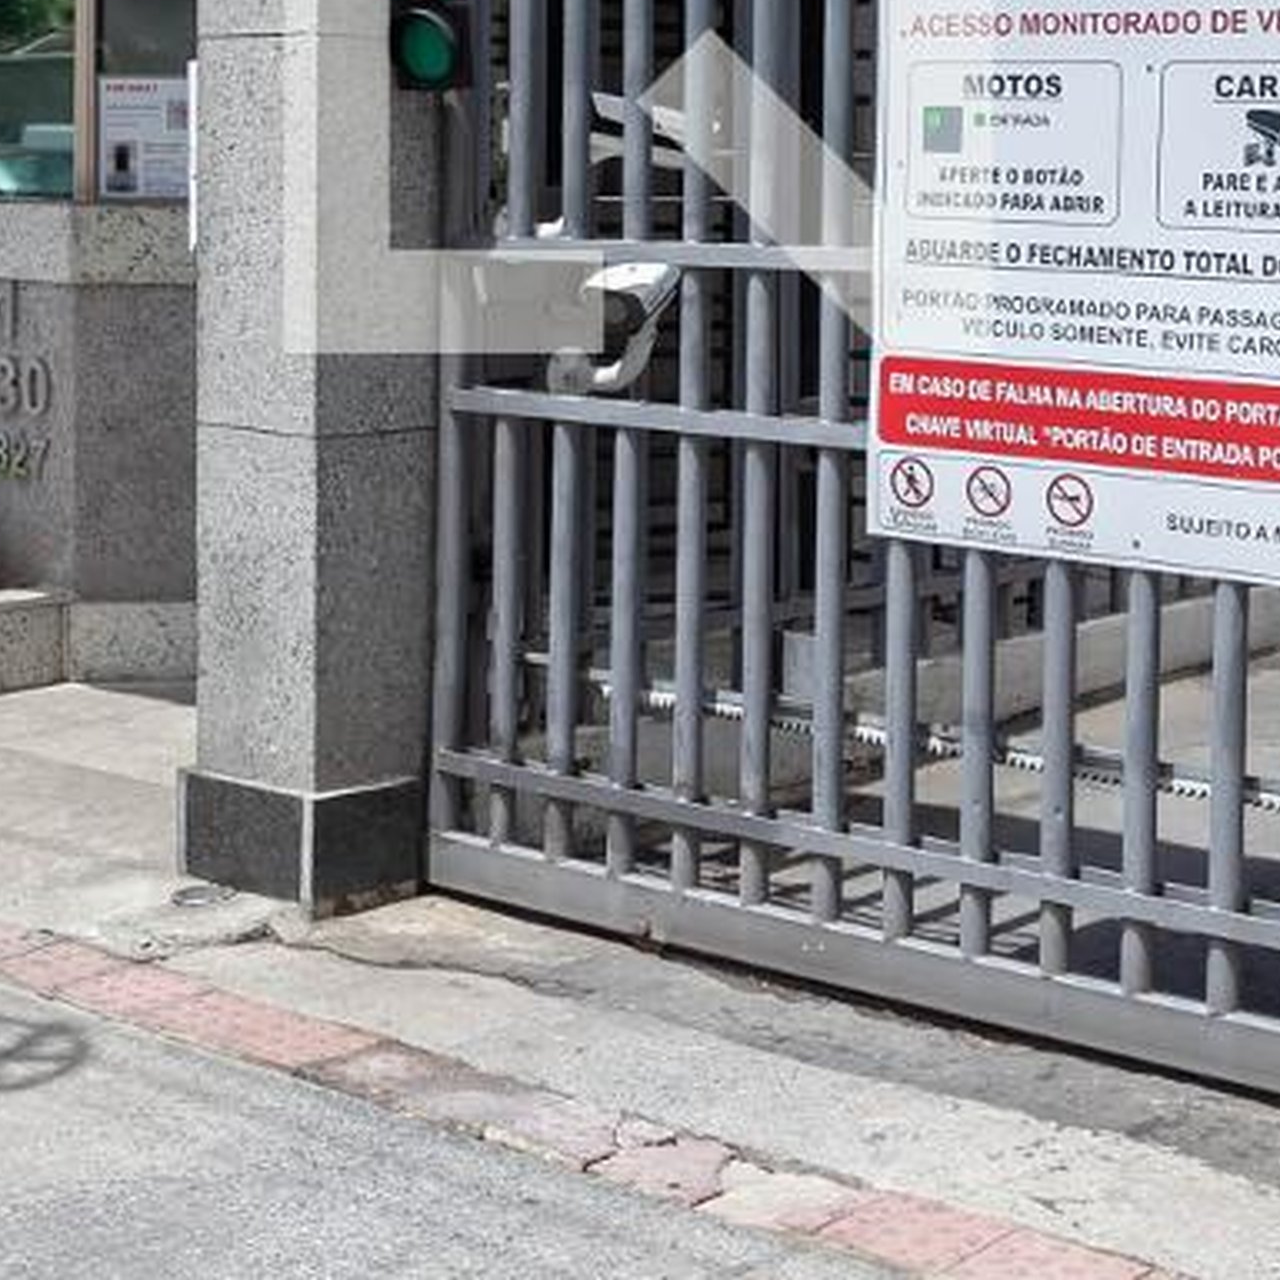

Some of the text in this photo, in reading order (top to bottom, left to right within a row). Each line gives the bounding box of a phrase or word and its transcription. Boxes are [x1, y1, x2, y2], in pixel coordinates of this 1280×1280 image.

[909, 12, 1013, 38] ACESSO
[1021, 10, 1201, 36] MONITORADO
[1211, 9, 1248, 34] DE
[963, 74, 1063, 98] MOTOS
[1006, 169, 1019, 185] O
[1202, 172, 1251, 192] PARE
[1256, 175, 1268, 192] E
[1000, 192, 1045, 212] PARA
[1050, 195, 1105, 215] ABRIR
[1183, 199, 1198, 218] A
[905, 239, 1000, 262] AGUARDE
[1006, 243, 1021, 265] O
[1027, 243, 1176, 272] FECHAMENTO
[1183, 250, 1254, 276] TOTAL
[985, 294, 1129, 321] PROGRAMADO
[1136, 302, 1192, 324] PARA
[1161, 329, 1221, 352] EVITE
[889, 372, 913, 395] EM
[917, 375, 965, 398] CASO
[969, 379, 992, 401] DE
[996, 381, 1053, 406] FALHA
[1056, 387, 1081, 408] NA
[1086, 389, 1187, 417] ABERTURA
[1192, 398, 1221, 421] DO
[906, 412, 961, 437] CHAVE
[965, 419, 1037, 446] VIRTUAL
[1131, 434, 1157, 457] DE
[1162, 438, 1254, 468] ENTRADA
[1166, 513, 1251, 540] SUJEITO
[1256, 524, 1270, 541] A
